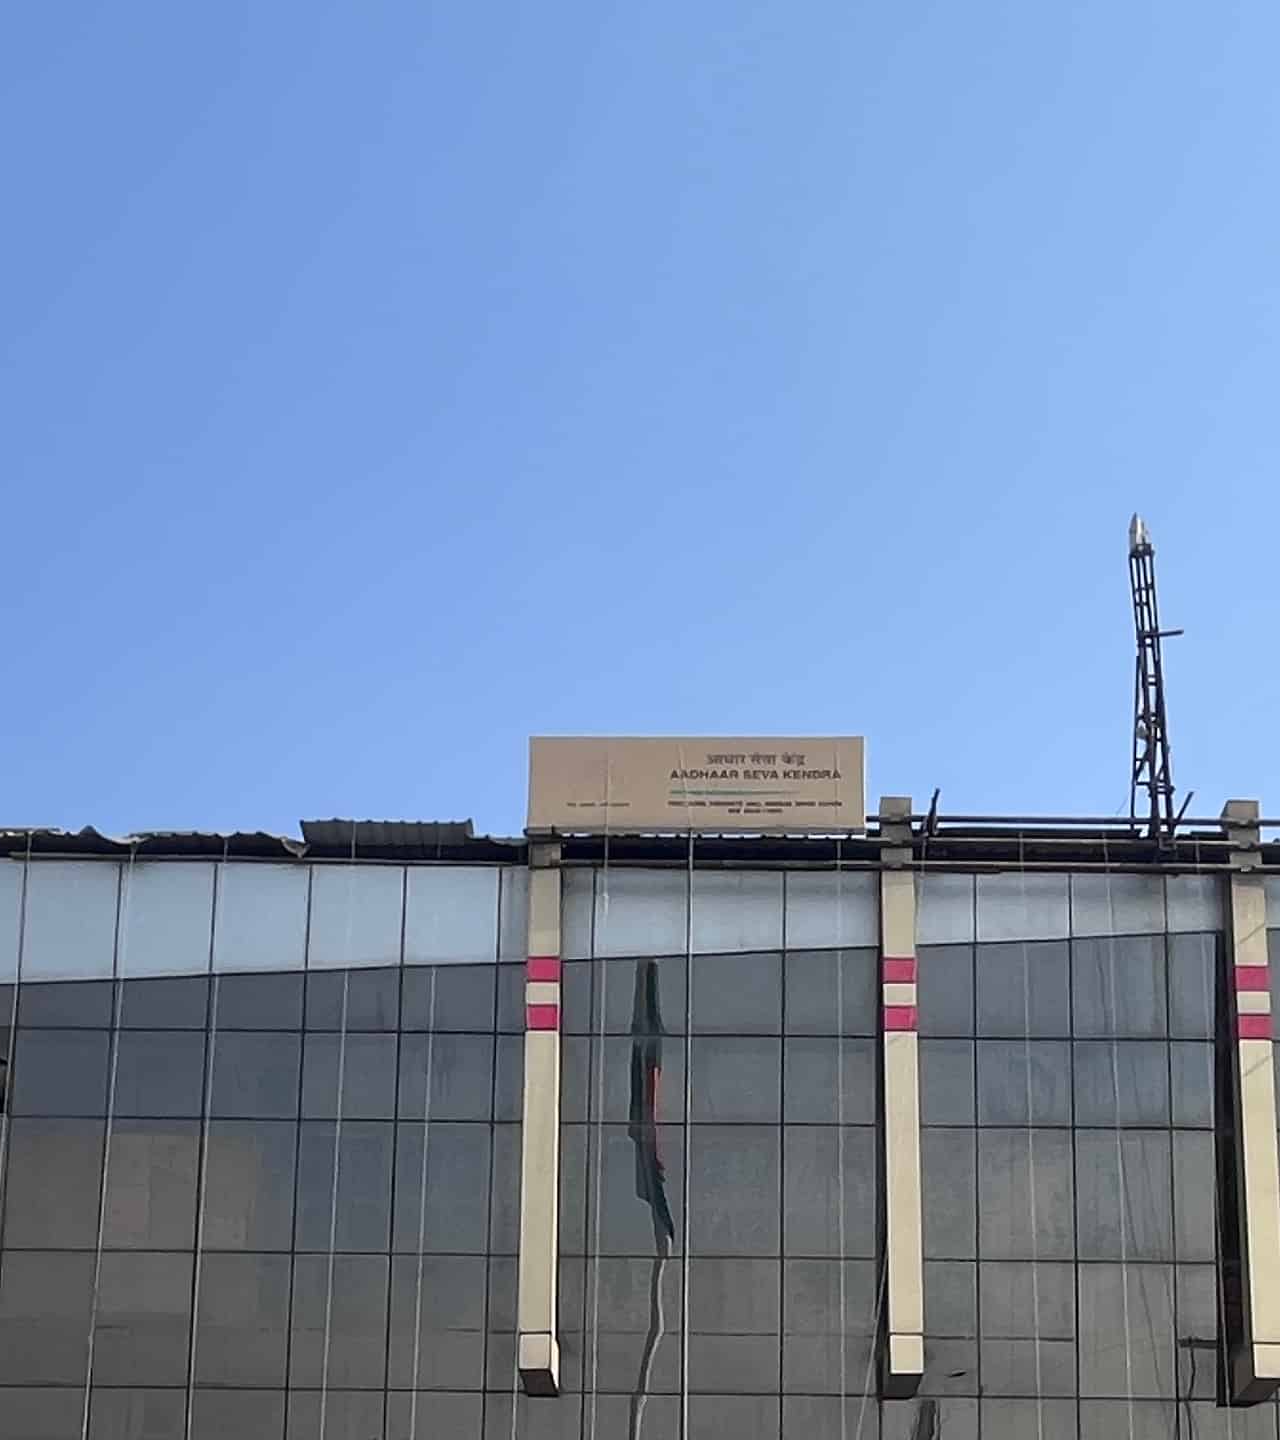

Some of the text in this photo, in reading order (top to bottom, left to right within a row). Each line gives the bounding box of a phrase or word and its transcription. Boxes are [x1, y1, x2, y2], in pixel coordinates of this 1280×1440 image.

[670, 769, 841, 779] AADHAAR SEVA KENDRA
